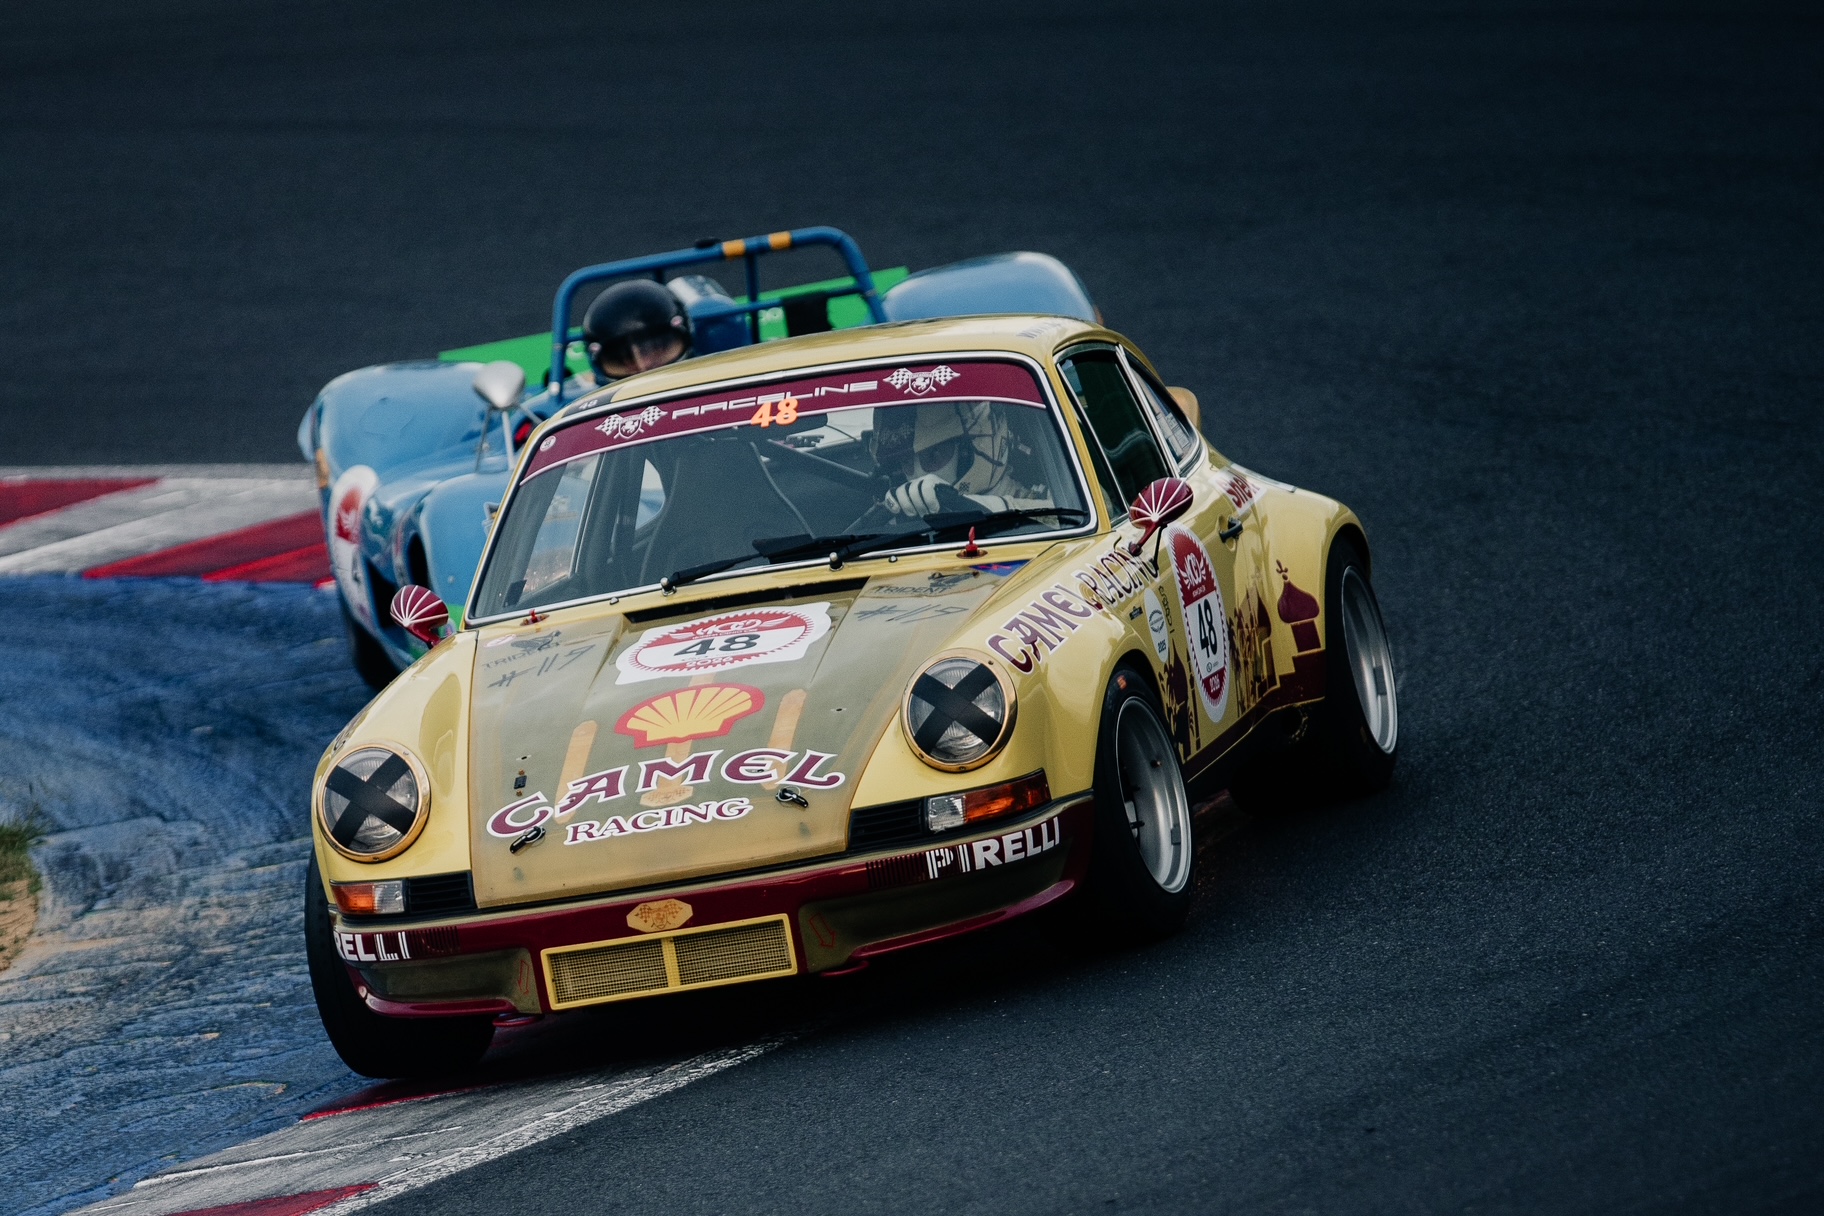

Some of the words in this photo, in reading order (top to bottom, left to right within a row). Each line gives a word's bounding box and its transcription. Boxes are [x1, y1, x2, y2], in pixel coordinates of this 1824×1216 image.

[750, 397, 799, 428] 48
[674, 633, 761, 657] 48
[985, 580, 1104, 676] CAMEL
[1198, 598, 1218, 658] 48
[486, 748, 845, 838] CAMEL
[563, 797, 753, 845] RACING
[925, 816, 1060, 880] PIRELLI
